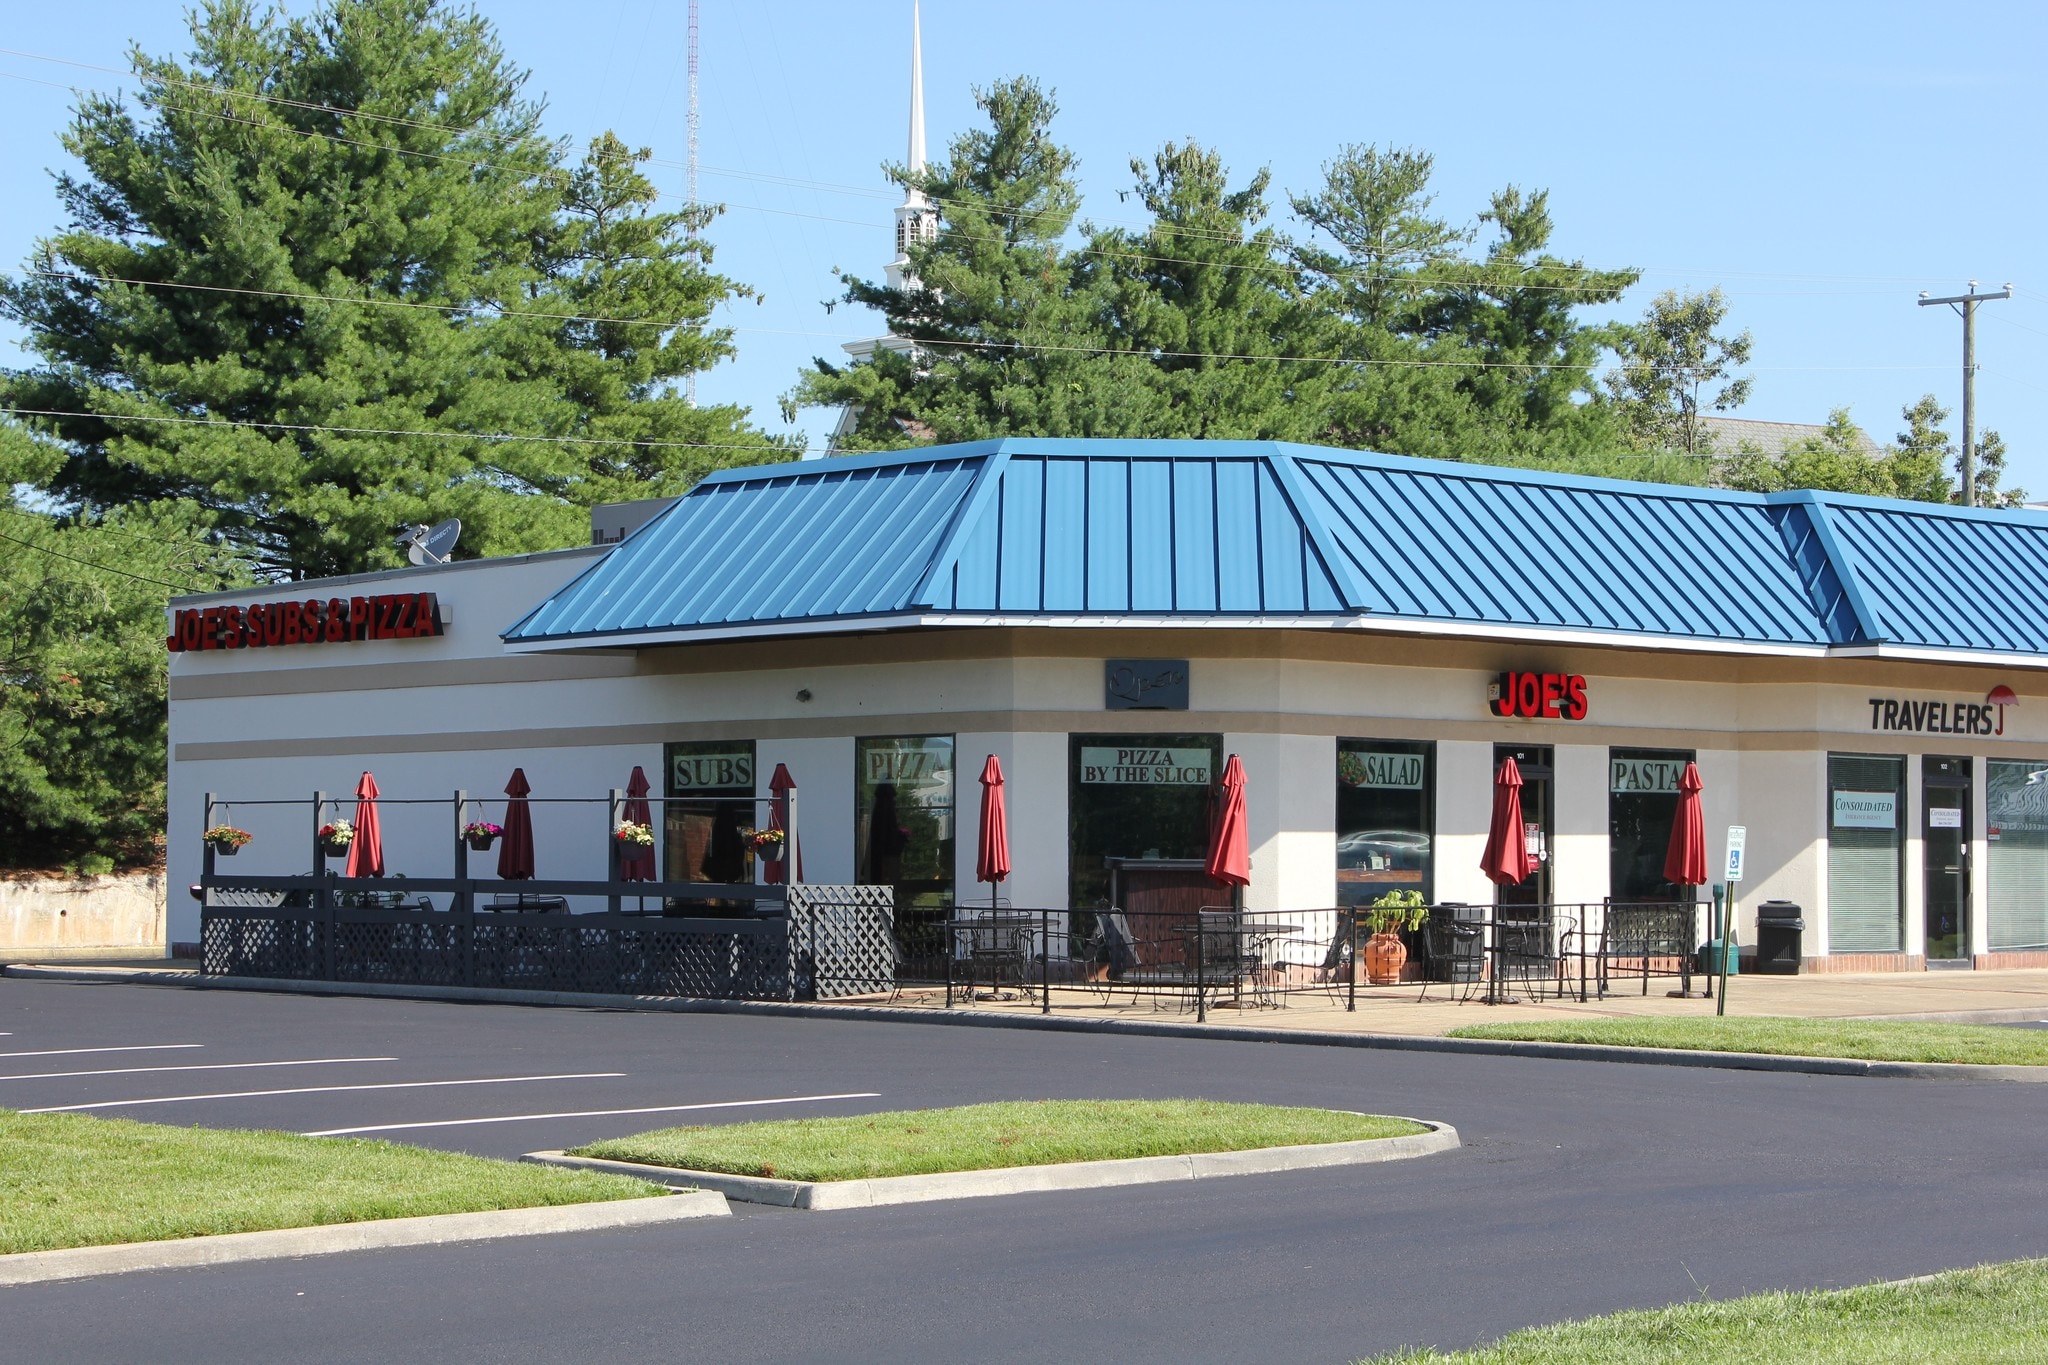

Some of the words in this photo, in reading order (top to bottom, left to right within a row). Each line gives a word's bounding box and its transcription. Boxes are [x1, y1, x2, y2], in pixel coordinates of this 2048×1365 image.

[166, 605, 244, 652] JOE'S
[246, 598, 322, 648] SUBS
[325, 597, 346, 643] &
[350, 592, 440, 641] PIZZA
[1494, 671, 1588, 720] JOE'S
[1869, 698, 1993, 735] TRAVELERS
[676, 757, 752, 787] SUBS
[869, 750, 945, 780] PIZZA
[1116, 749, 1175, 765] PIZZA
[1366, 755, 1421, 786] SALAD
[1084, 766, 1109, 782] BY
[1112, 766, 1150, 782] THE
[1154, 767, 1207, 783] SLICE
[1612, 762, 1681, 791] PASTA
